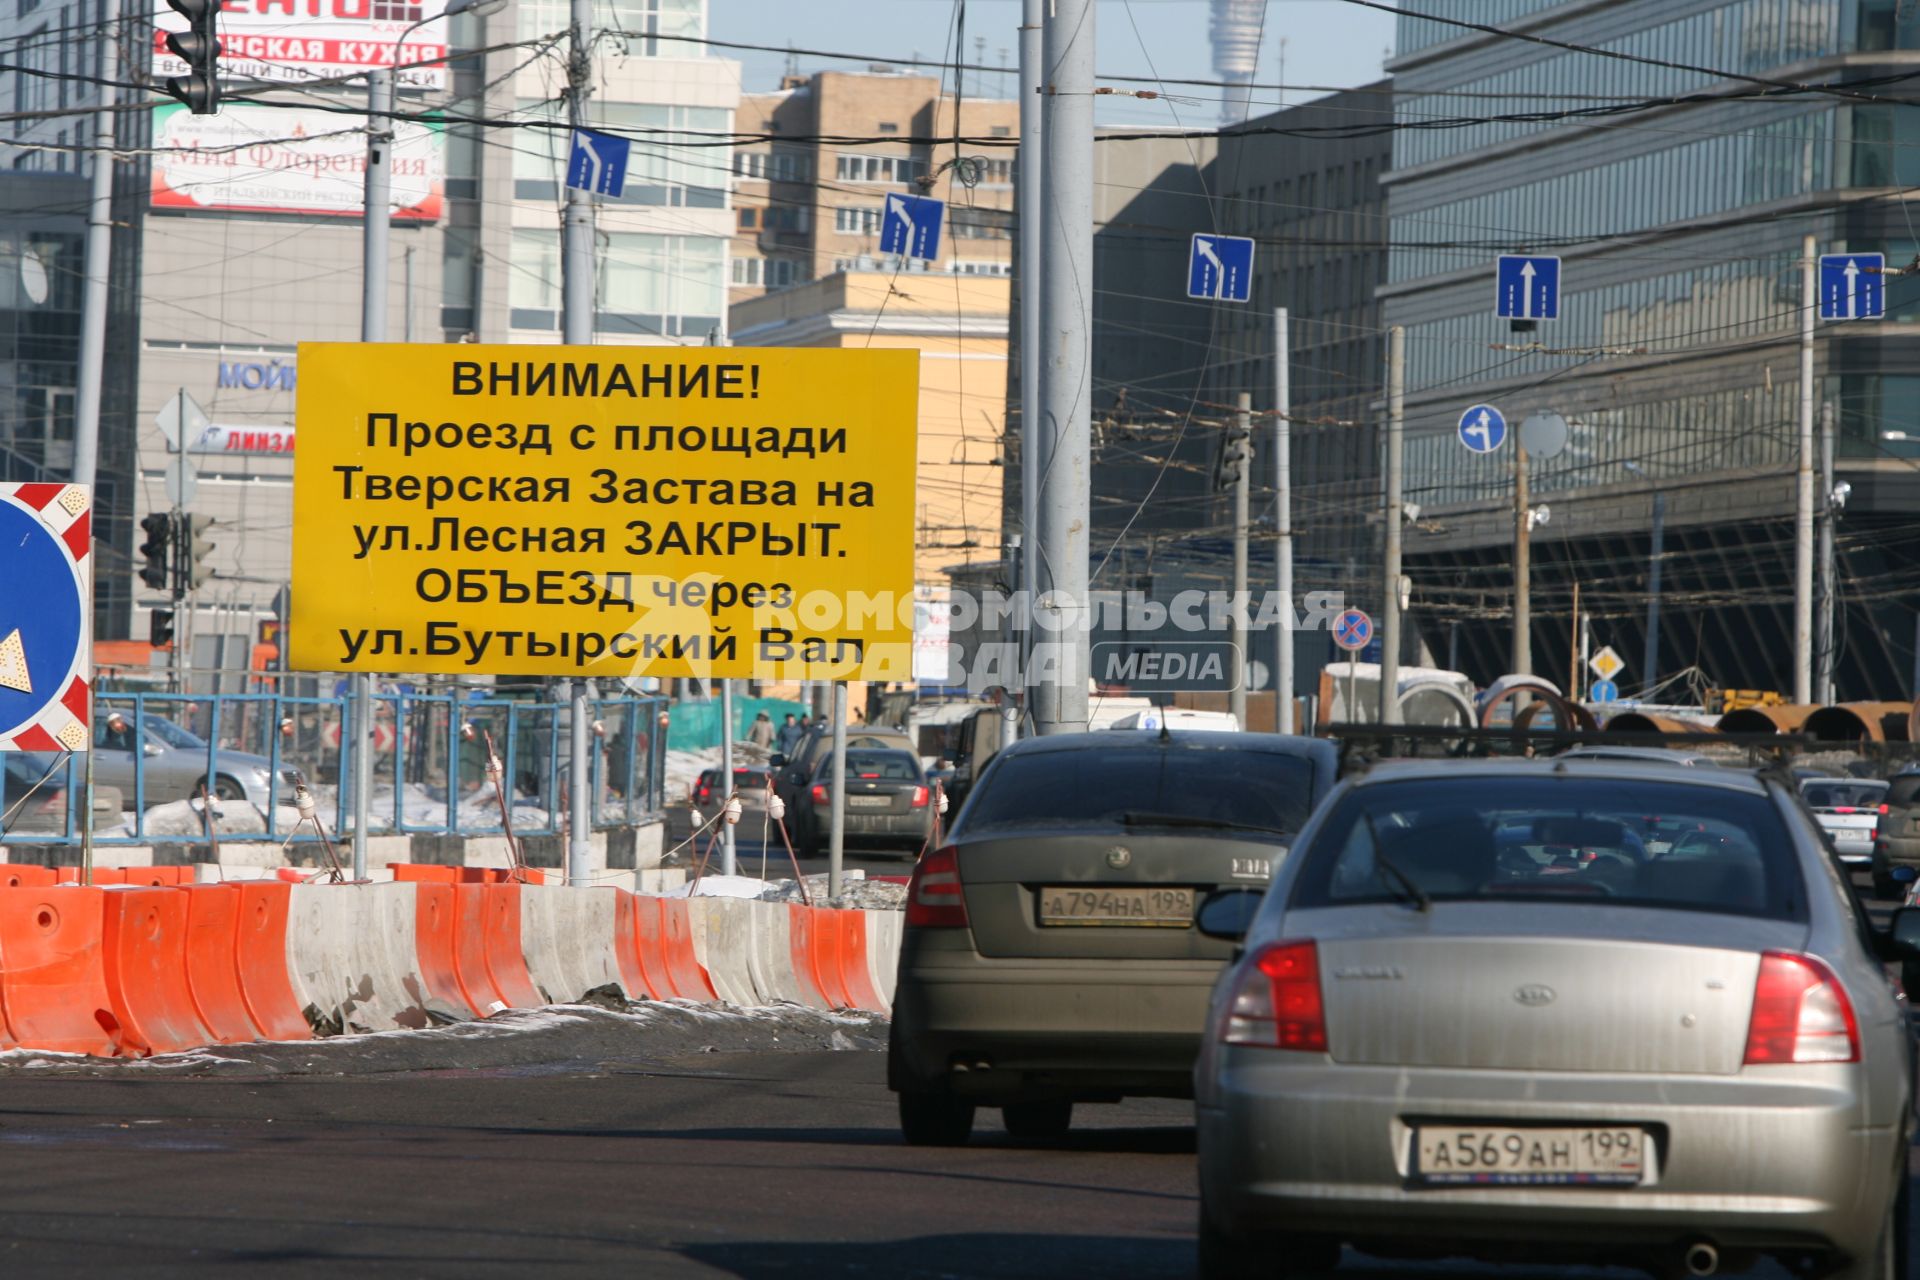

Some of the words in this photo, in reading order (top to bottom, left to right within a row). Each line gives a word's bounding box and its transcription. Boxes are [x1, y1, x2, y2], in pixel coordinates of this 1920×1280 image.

[338, 41, 440, 64] КУХНЯ
[170, 137, 237, 166] Миа
[248, 145, 427, 178] Флорения
[453, 361, 759, 399] ВНИМАНИЕ!
[367, 412, 552, 457] Проезд
[570, 424, 595, 450] с
[615, 425, 846, 459] площади
[333, 465, 571, 510] Тверская
[590, 468, 796, 505] Застава
[817, 481, 874, 508] на
[353, 517, 605, 560] ул.Лесная
[624, 520, 848, 557] ЗАКРЫТ.
[415, 567, 634, 613] ОБЪЕЗД
[652, 580, 794, 617] через
[339, 624, 737, 668] ул.Бутырский
[759, 627, 864, 664] Вал
[1151, 891, 1187, 911] 199
[1433, 1133, 1570, 1167] А569АН
[1581, 1131, 1632, 1158] 199
